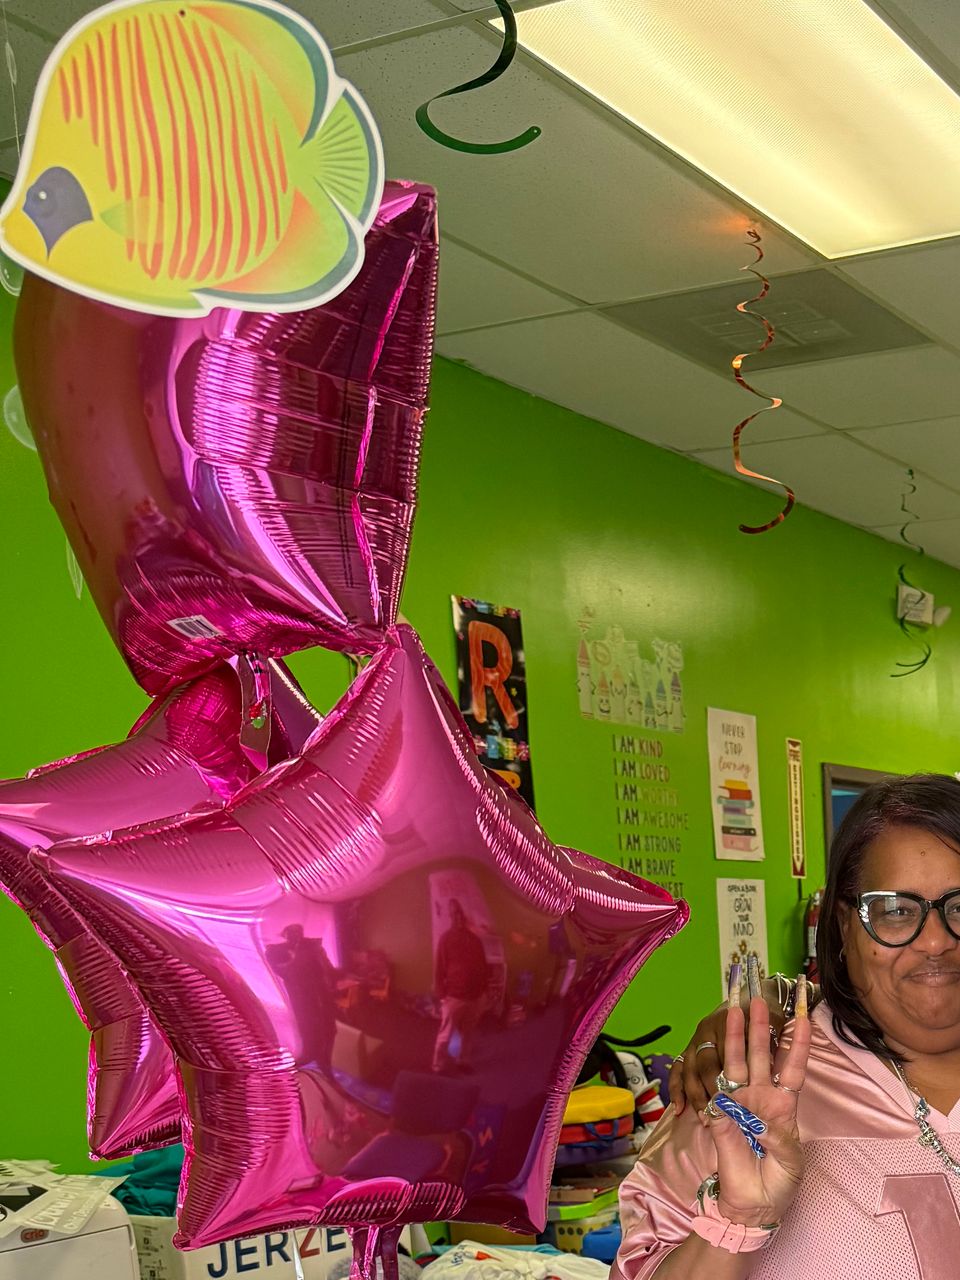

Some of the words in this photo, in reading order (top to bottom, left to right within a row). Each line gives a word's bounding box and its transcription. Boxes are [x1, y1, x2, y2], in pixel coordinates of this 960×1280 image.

[468, 620, 519, 730] R
[722, 723, 746, 738] NEVER
[620, 736, 635, 753] AM
[639, 739, 663, 758] KIND
[724, 742, 743, 756] STOP
[621, 760, 636, 778] AM
[640, 764, 670, 782] LOVED
[718, 756, 752, 779] learning
[623, 784, 638, 802] AM
[624, 808, 639, 826] AM
[643, 813, 689, 830] AWESOME
[626, 834, 641, 851] AM
[644, 835, 681, 853] STRONG
[628, 858, 643, 875] AM
[646, 859, 676, 877] BRAVE
[734, 898, 752, 913] GROW
[733, 922, 754, 936] MIND
[207, 1227, 347, 1278] JERZE
